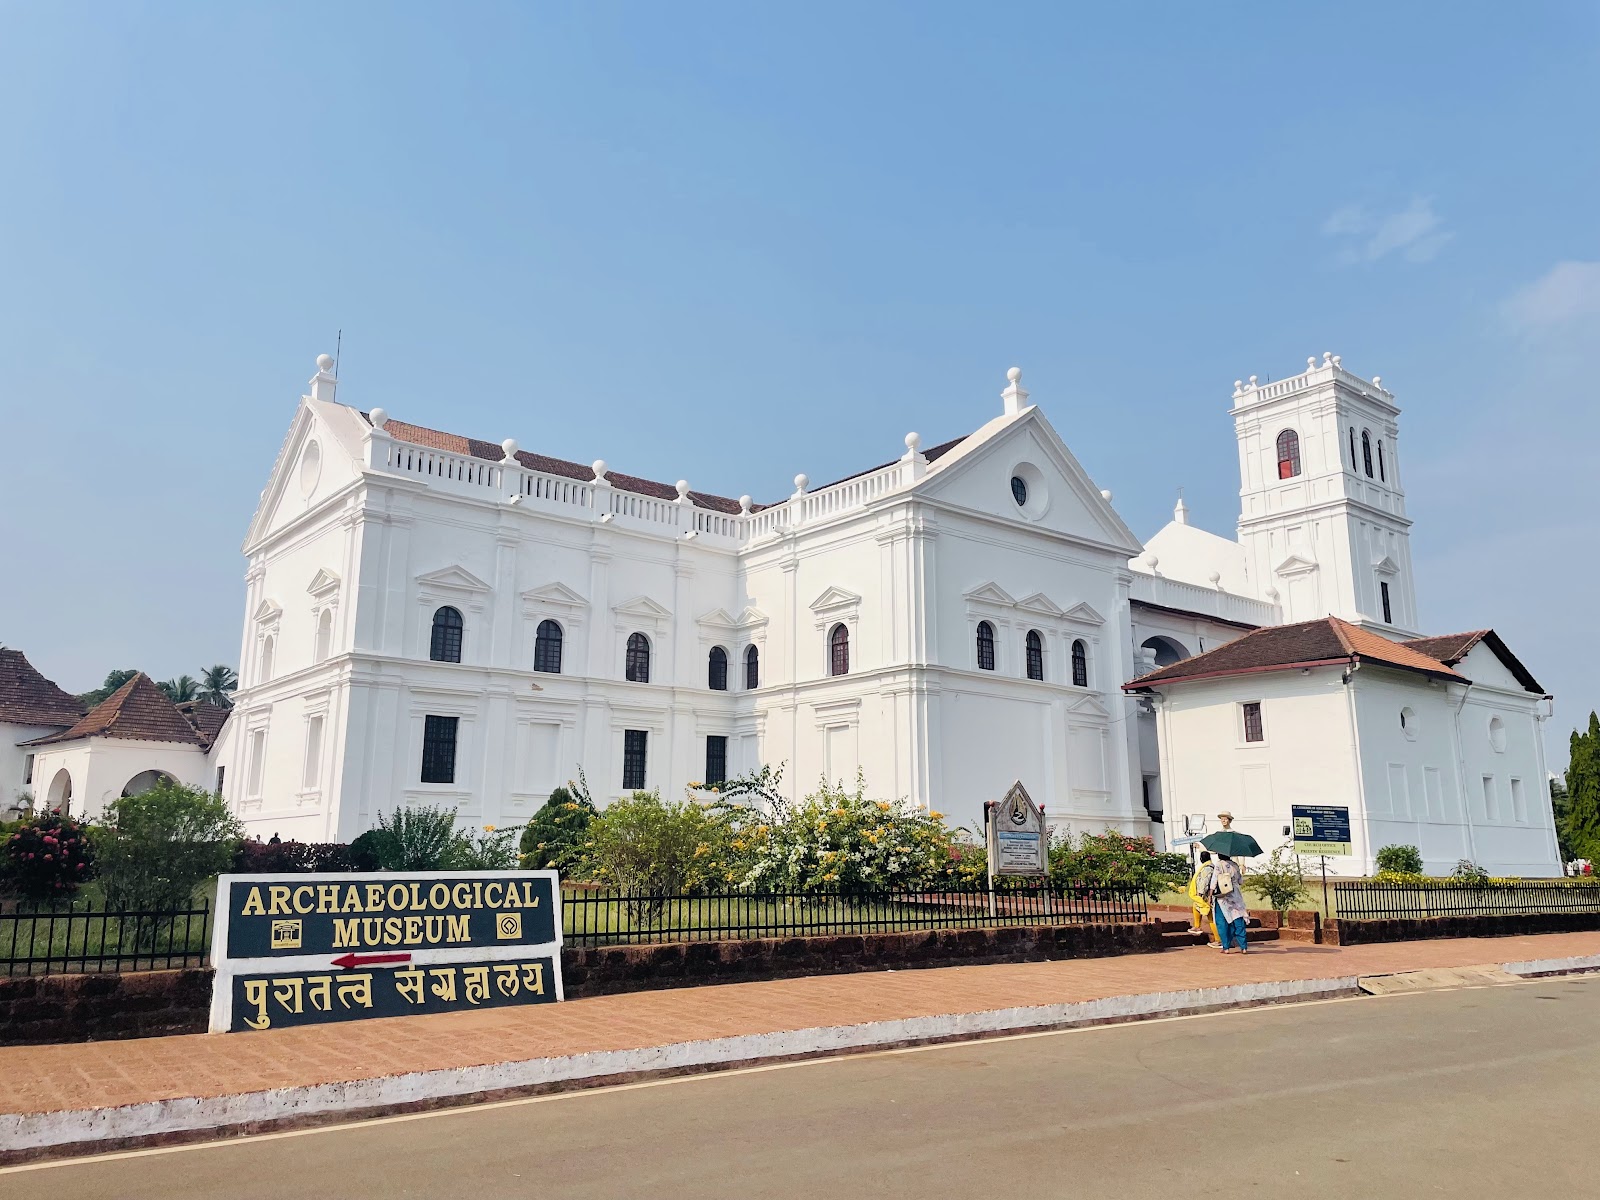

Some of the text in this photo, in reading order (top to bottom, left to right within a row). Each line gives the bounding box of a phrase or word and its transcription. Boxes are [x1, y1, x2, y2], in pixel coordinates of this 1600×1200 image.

[241, 881, 540, 916] ARCHAEOLOGICAL
[332, 914, 472, 948] MUSEUM
[243, 963, 545, 1030] पुरातत्व संग्रहालय
